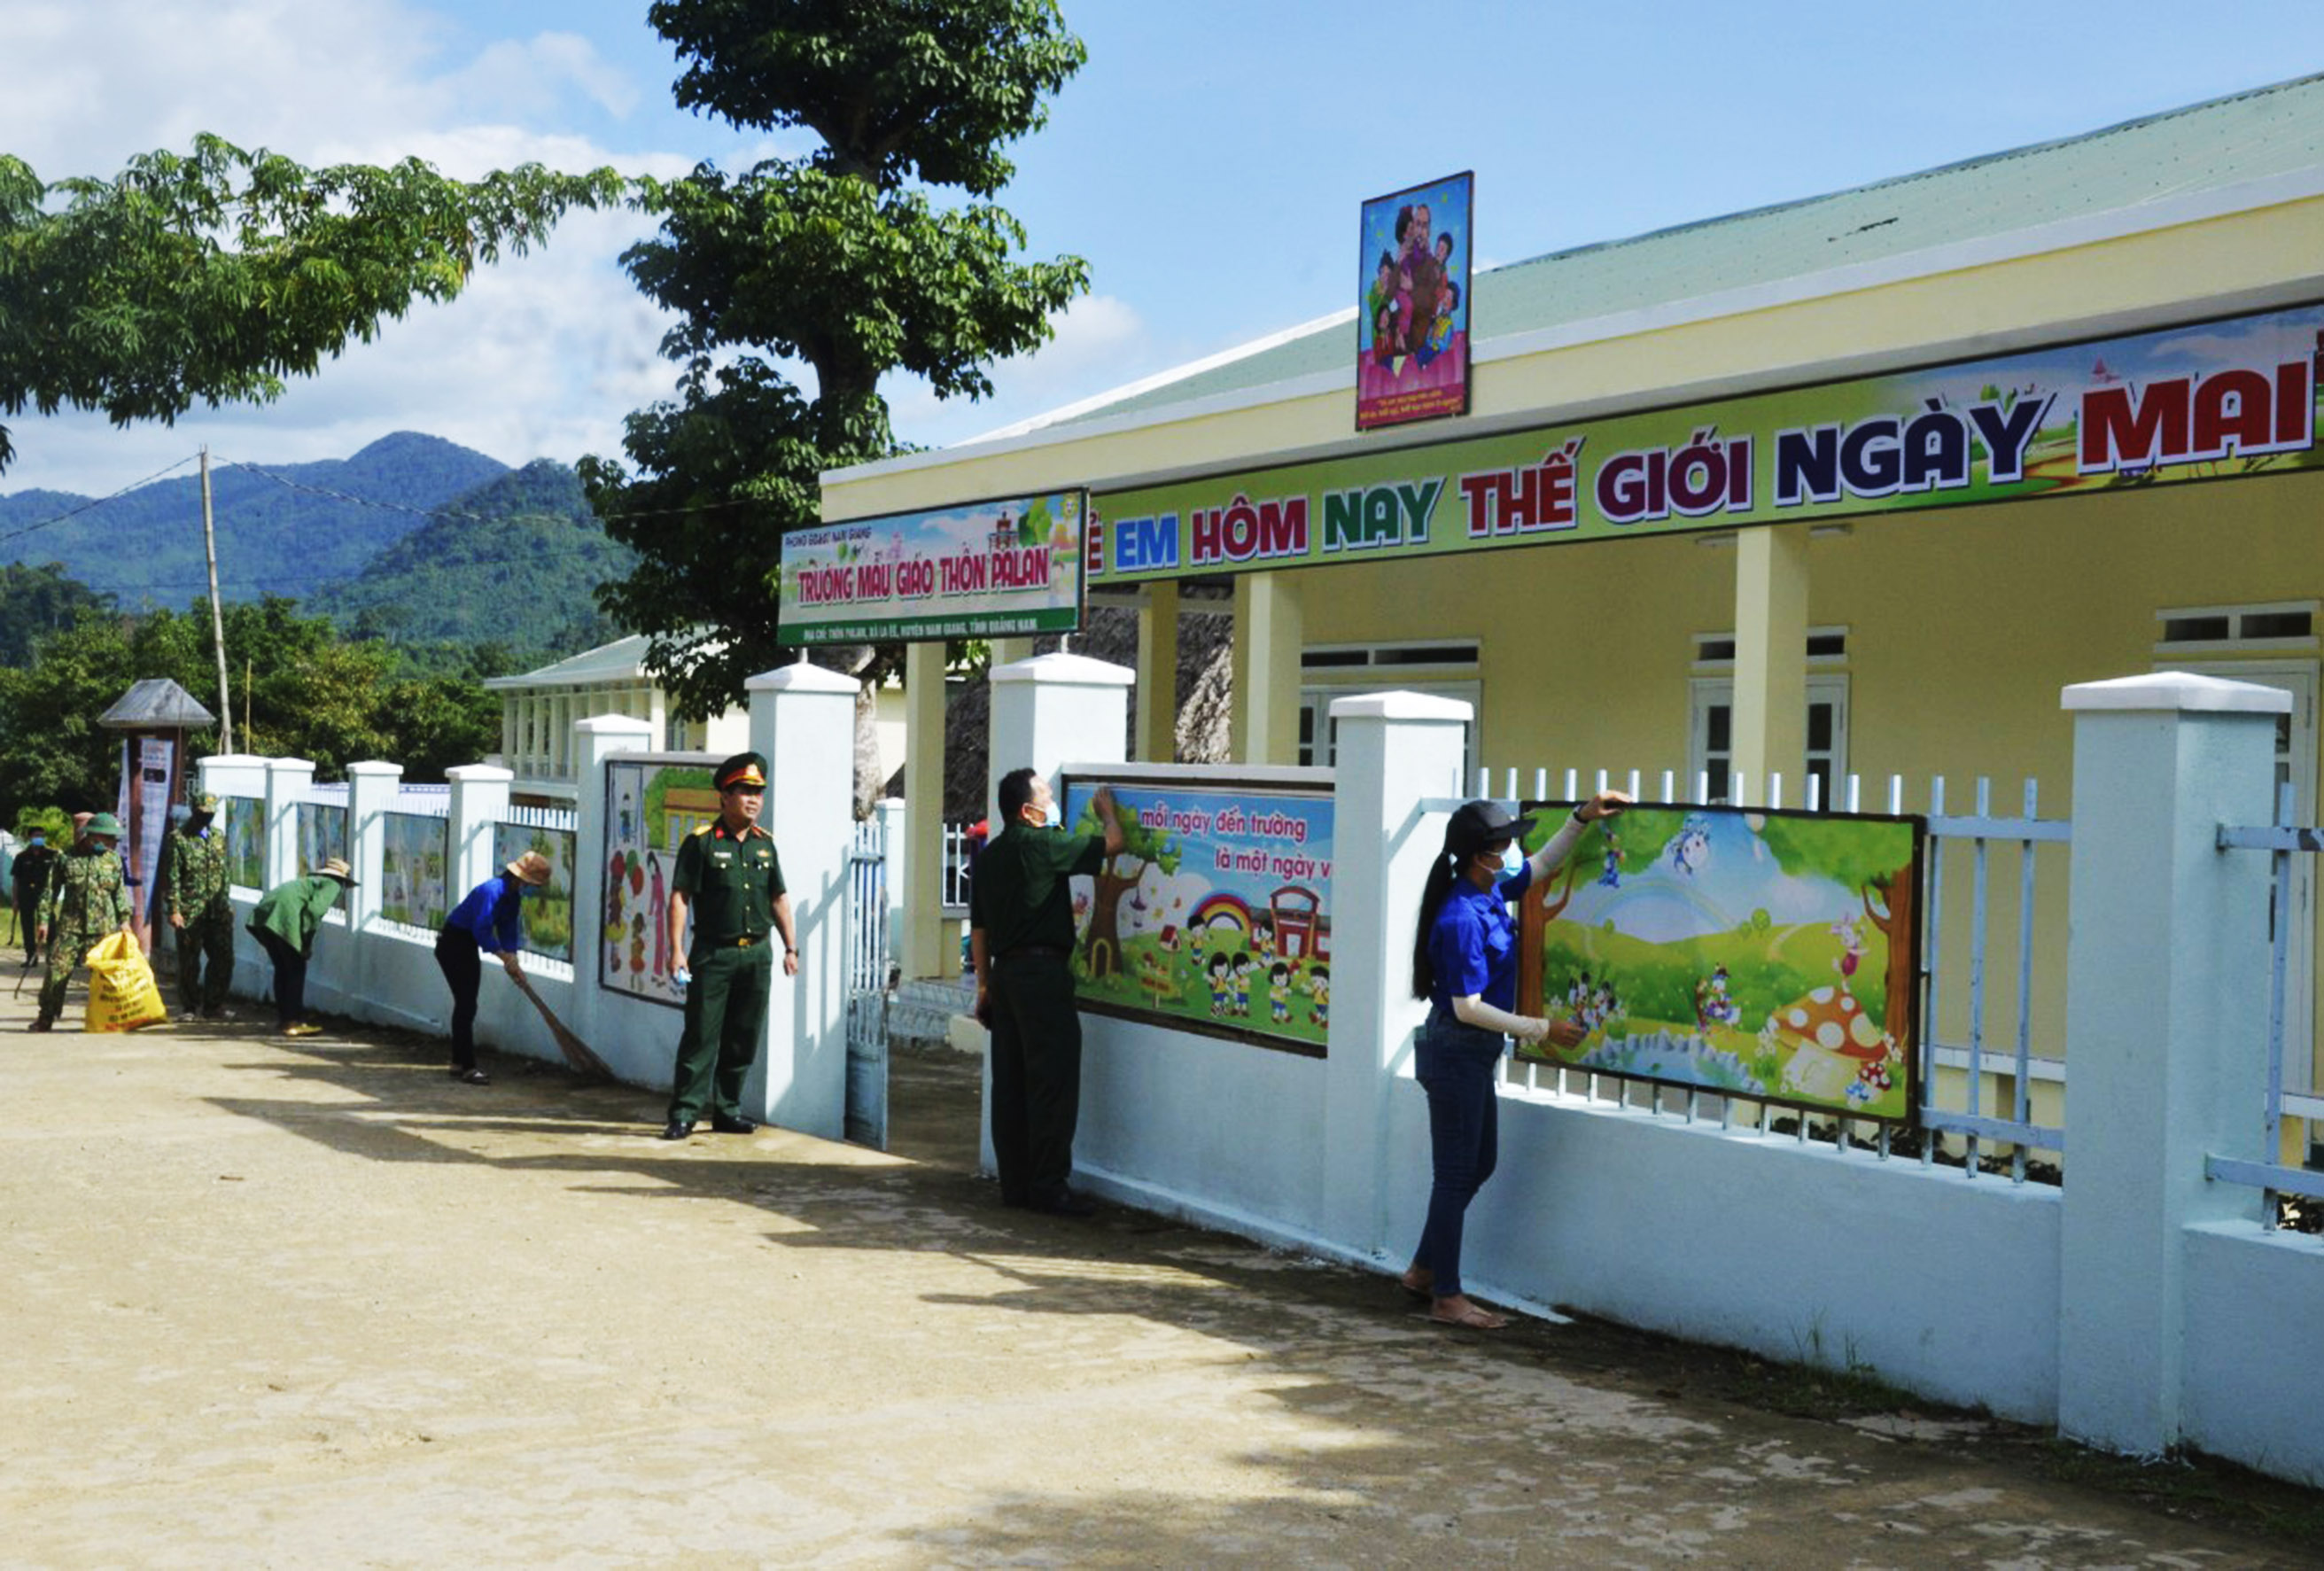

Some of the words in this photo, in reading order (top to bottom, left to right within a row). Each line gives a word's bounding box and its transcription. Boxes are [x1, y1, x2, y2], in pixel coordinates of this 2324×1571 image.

[1115, 514, 1178, 570] EM
[1191, 494, 1308, 563] HÔM
[1325, 478, 1445, 549] NAY
[1460, 437, 1584, 535] THẾ
[1597, 427, 1752, 522] GIỚI
[1776, 393, 2054, 504] NGÀY
[2079, 356, 2312, 472] MAI
[896, 553, 935, 596] GIÁO
[939, 548, 986, 593] THÔN
[991, 548, 1049, 589] PALAN
[1173, 807, 1210, 835] ngày
[1216, 807, 1245, 832] đến
[1251, 813, 1306, 844] trường
[1216, 847, 1231, 869] là
[1235, 850, 1268, 876] một
[1272, 854, 1315, 881] ngày
